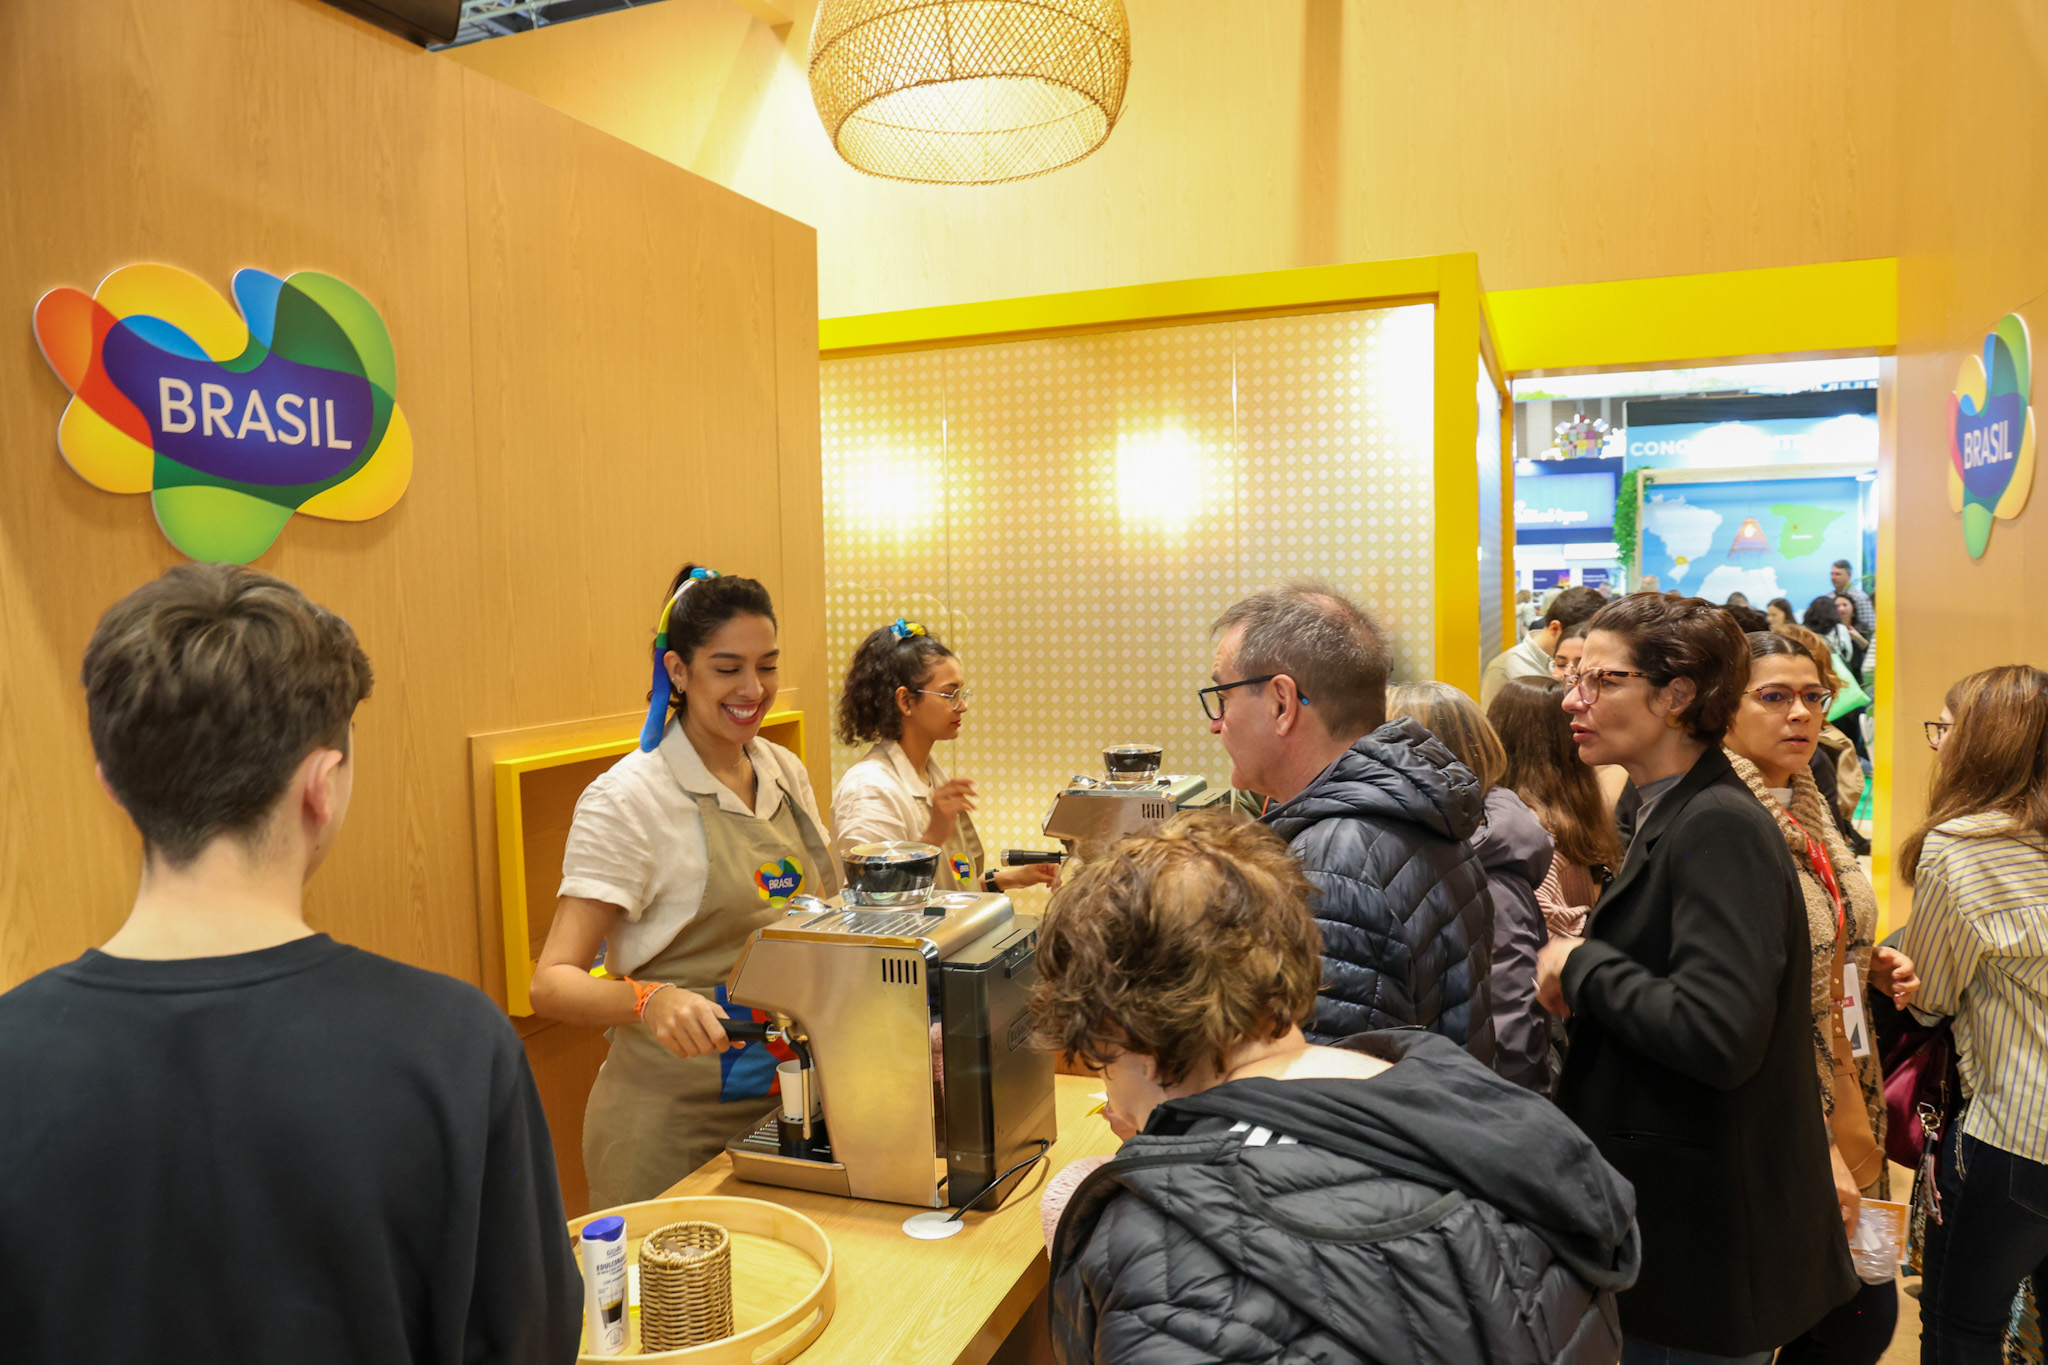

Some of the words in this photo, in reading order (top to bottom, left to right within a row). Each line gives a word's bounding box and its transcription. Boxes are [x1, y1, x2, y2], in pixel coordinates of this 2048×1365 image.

[158, 376, 353, 450] BRASIL
[1964, 420, 2013, 470] BRASIL
[769, 877, 794, 890] BRASIL
